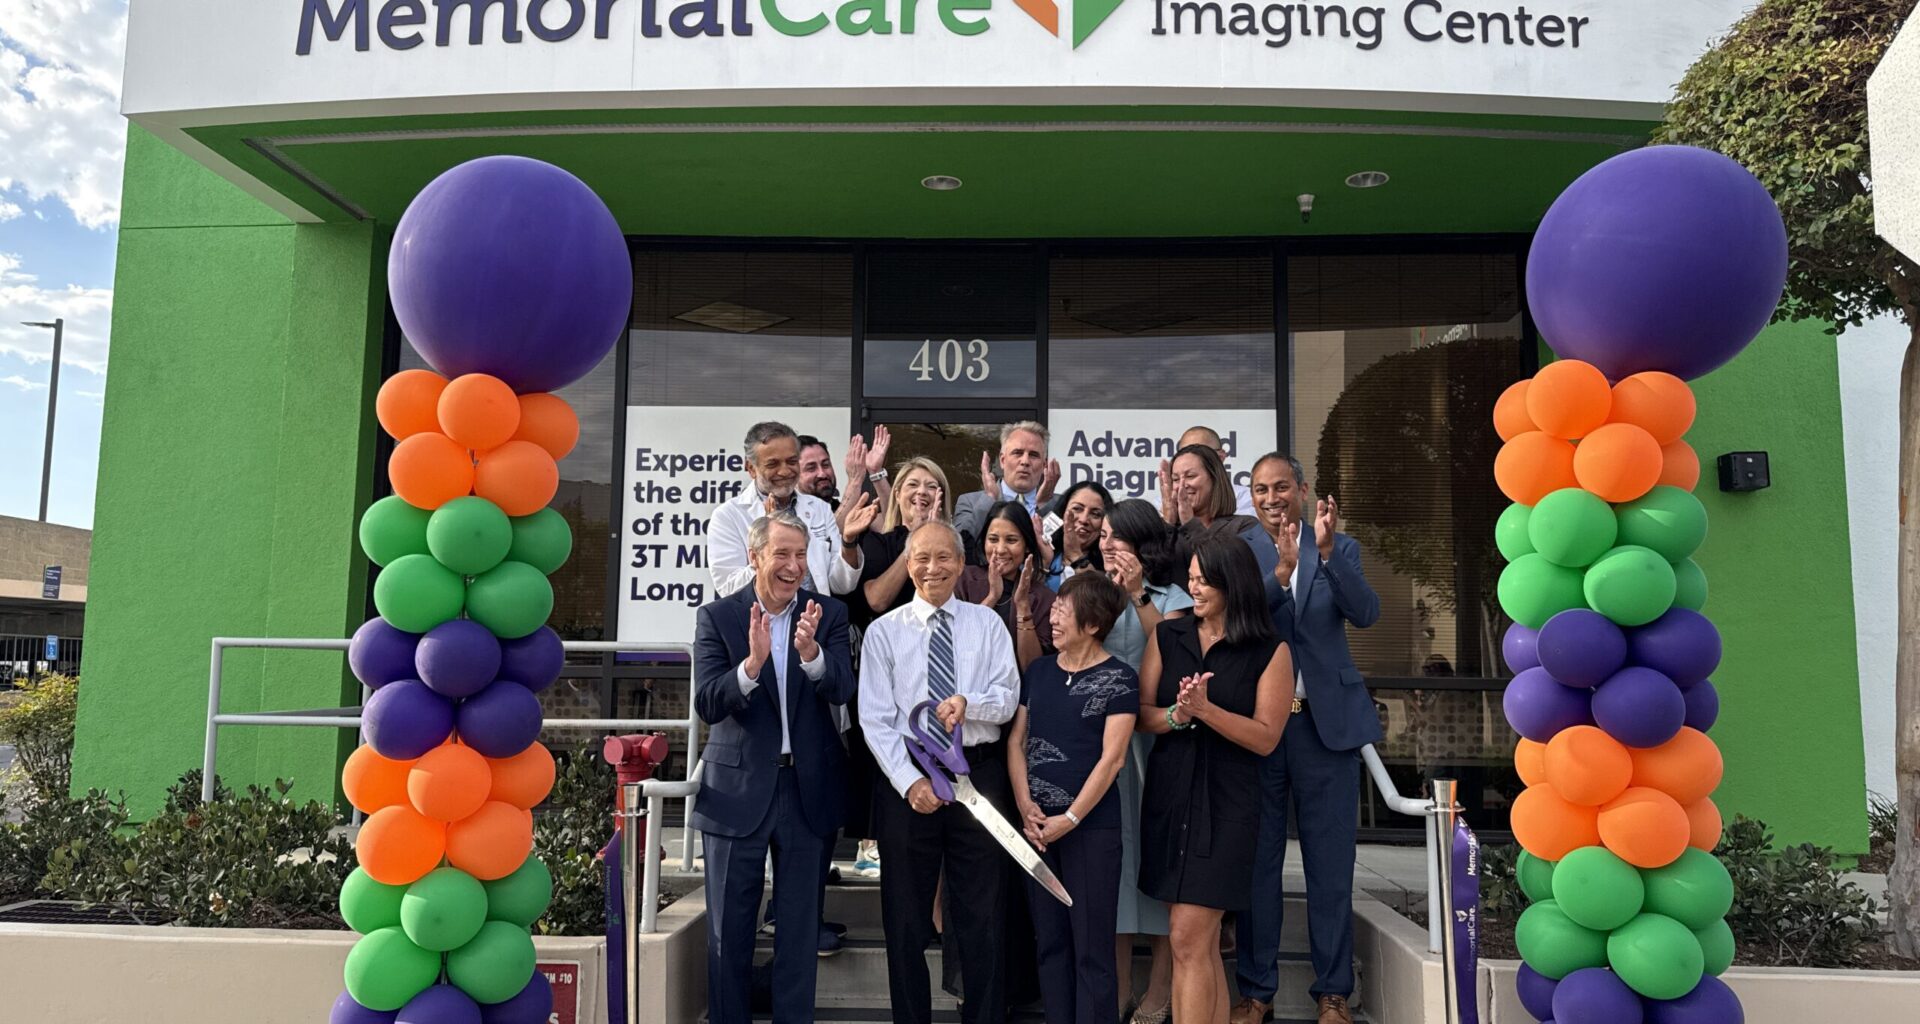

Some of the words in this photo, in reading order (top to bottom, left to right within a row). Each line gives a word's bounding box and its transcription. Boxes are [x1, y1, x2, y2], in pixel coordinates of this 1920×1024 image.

[1151, 0, 1386, 50] Imaging
[1404, 0, 1590, 48] Center
[909, 339, 990, 382] 403
[1067, 430, 1237, 458] Advand
[635, 448, 749, 477] Experie
[633, 481, 683, 504] the
[632, 512, 664, 536] of
[630, 544, 669, 568] 3T
[630, 576, 704, 607] Long
[559, 972, 573, 985] #10
